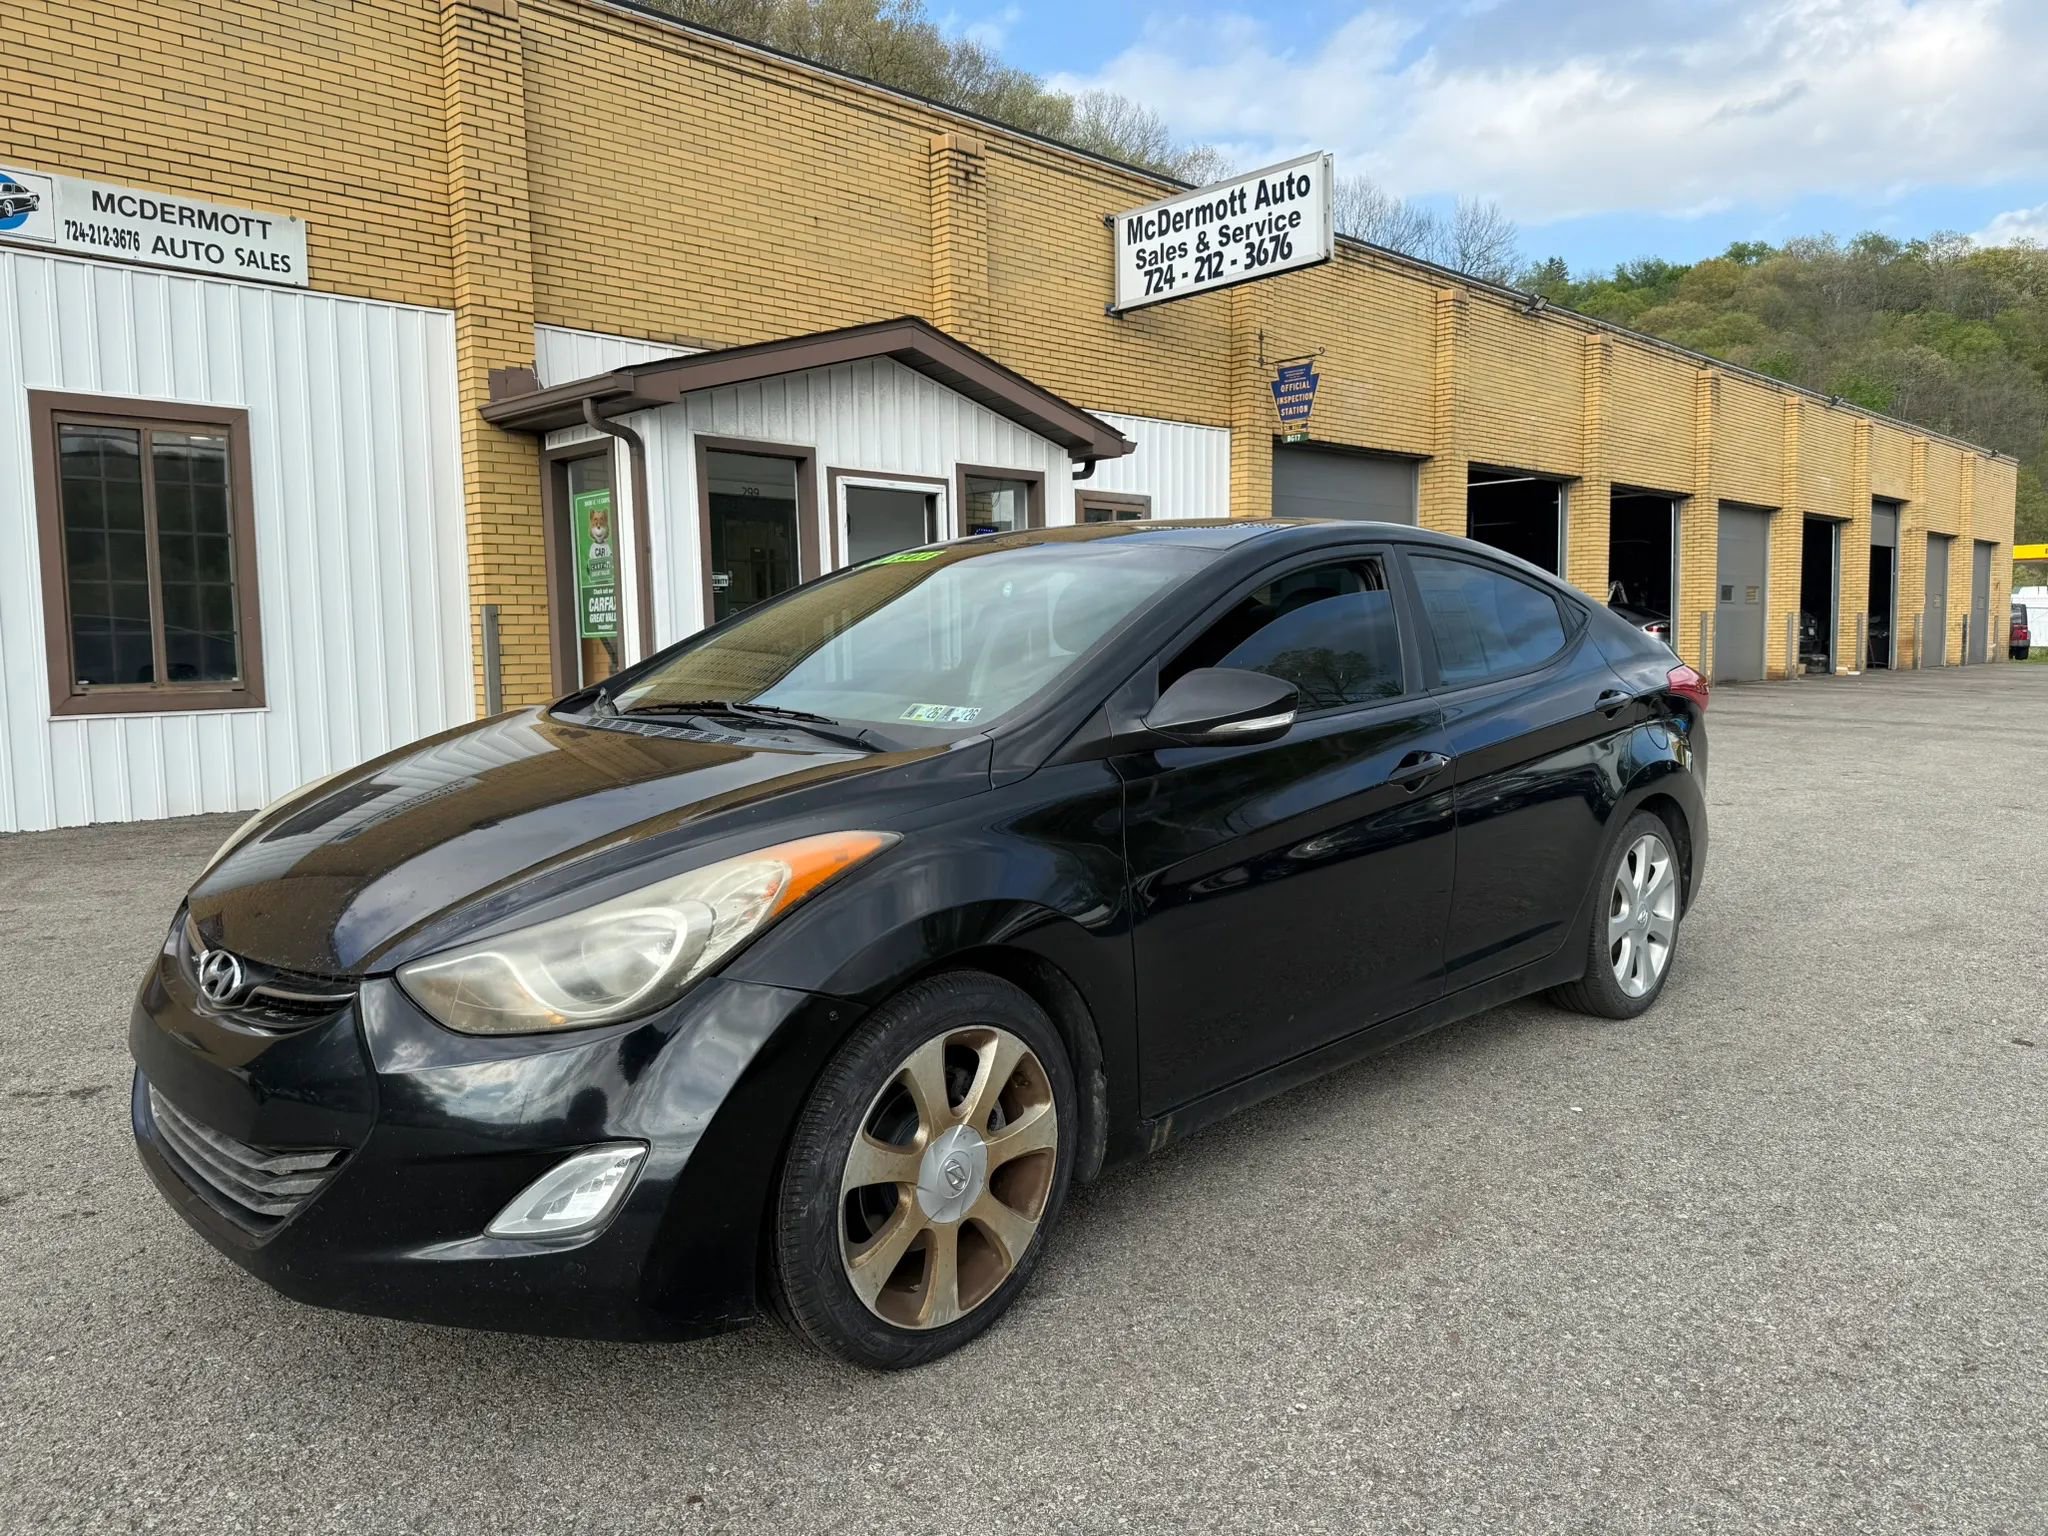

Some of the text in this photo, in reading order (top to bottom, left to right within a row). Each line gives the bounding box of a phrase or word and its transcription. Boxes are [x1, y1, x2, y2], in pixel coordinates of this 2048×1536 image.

[91, 190, 273, 240] MCDERMOTT
[1127, 171, 1311, 246] McDermott Auto
[64, 220, 140, 251] 724-212-3676
[1135, 210, 1301, 270] Sales & Service
[151, 235, 292, 273] AUTO SALES
[1143, 263, 1175, 296] 724
[1194, 250, 1224, 284] 212
[1244, 232, 1293, 270] 3676
[1277, 392, 1314, 405] INSPECTION
[1280, 380, 1311, 393] OFFICIAL
[1280, 405, 1309, 416] STATION
[589, 612, 605, 624] GREAT
